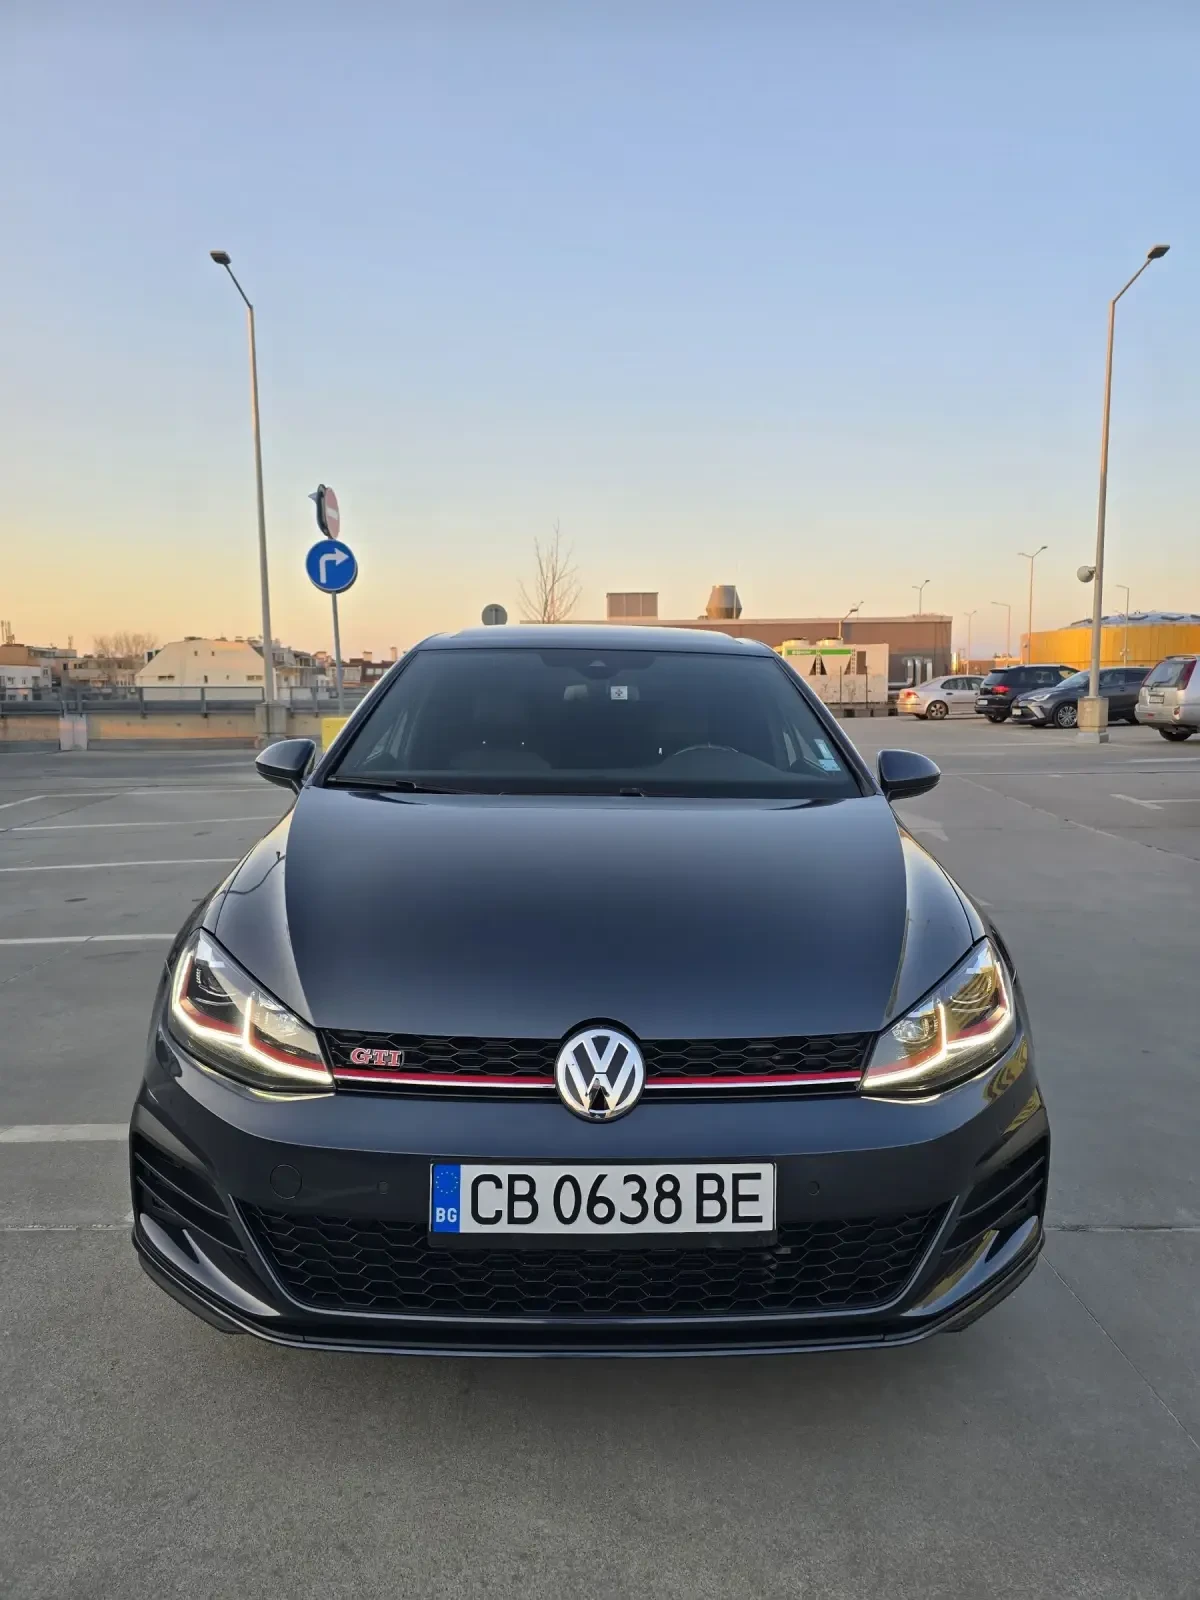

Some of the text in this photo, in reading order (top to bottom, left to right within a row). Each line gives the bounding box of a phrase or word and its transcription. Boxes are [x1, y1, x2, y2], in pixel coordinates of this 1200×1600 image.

[350, 1047, 402, 1067] GTI
[559, 1028, 644, 1120] VW
[435, 1207, 458, 1223] BG
[470, 1172, 763, 1226] CB 0638 BE
